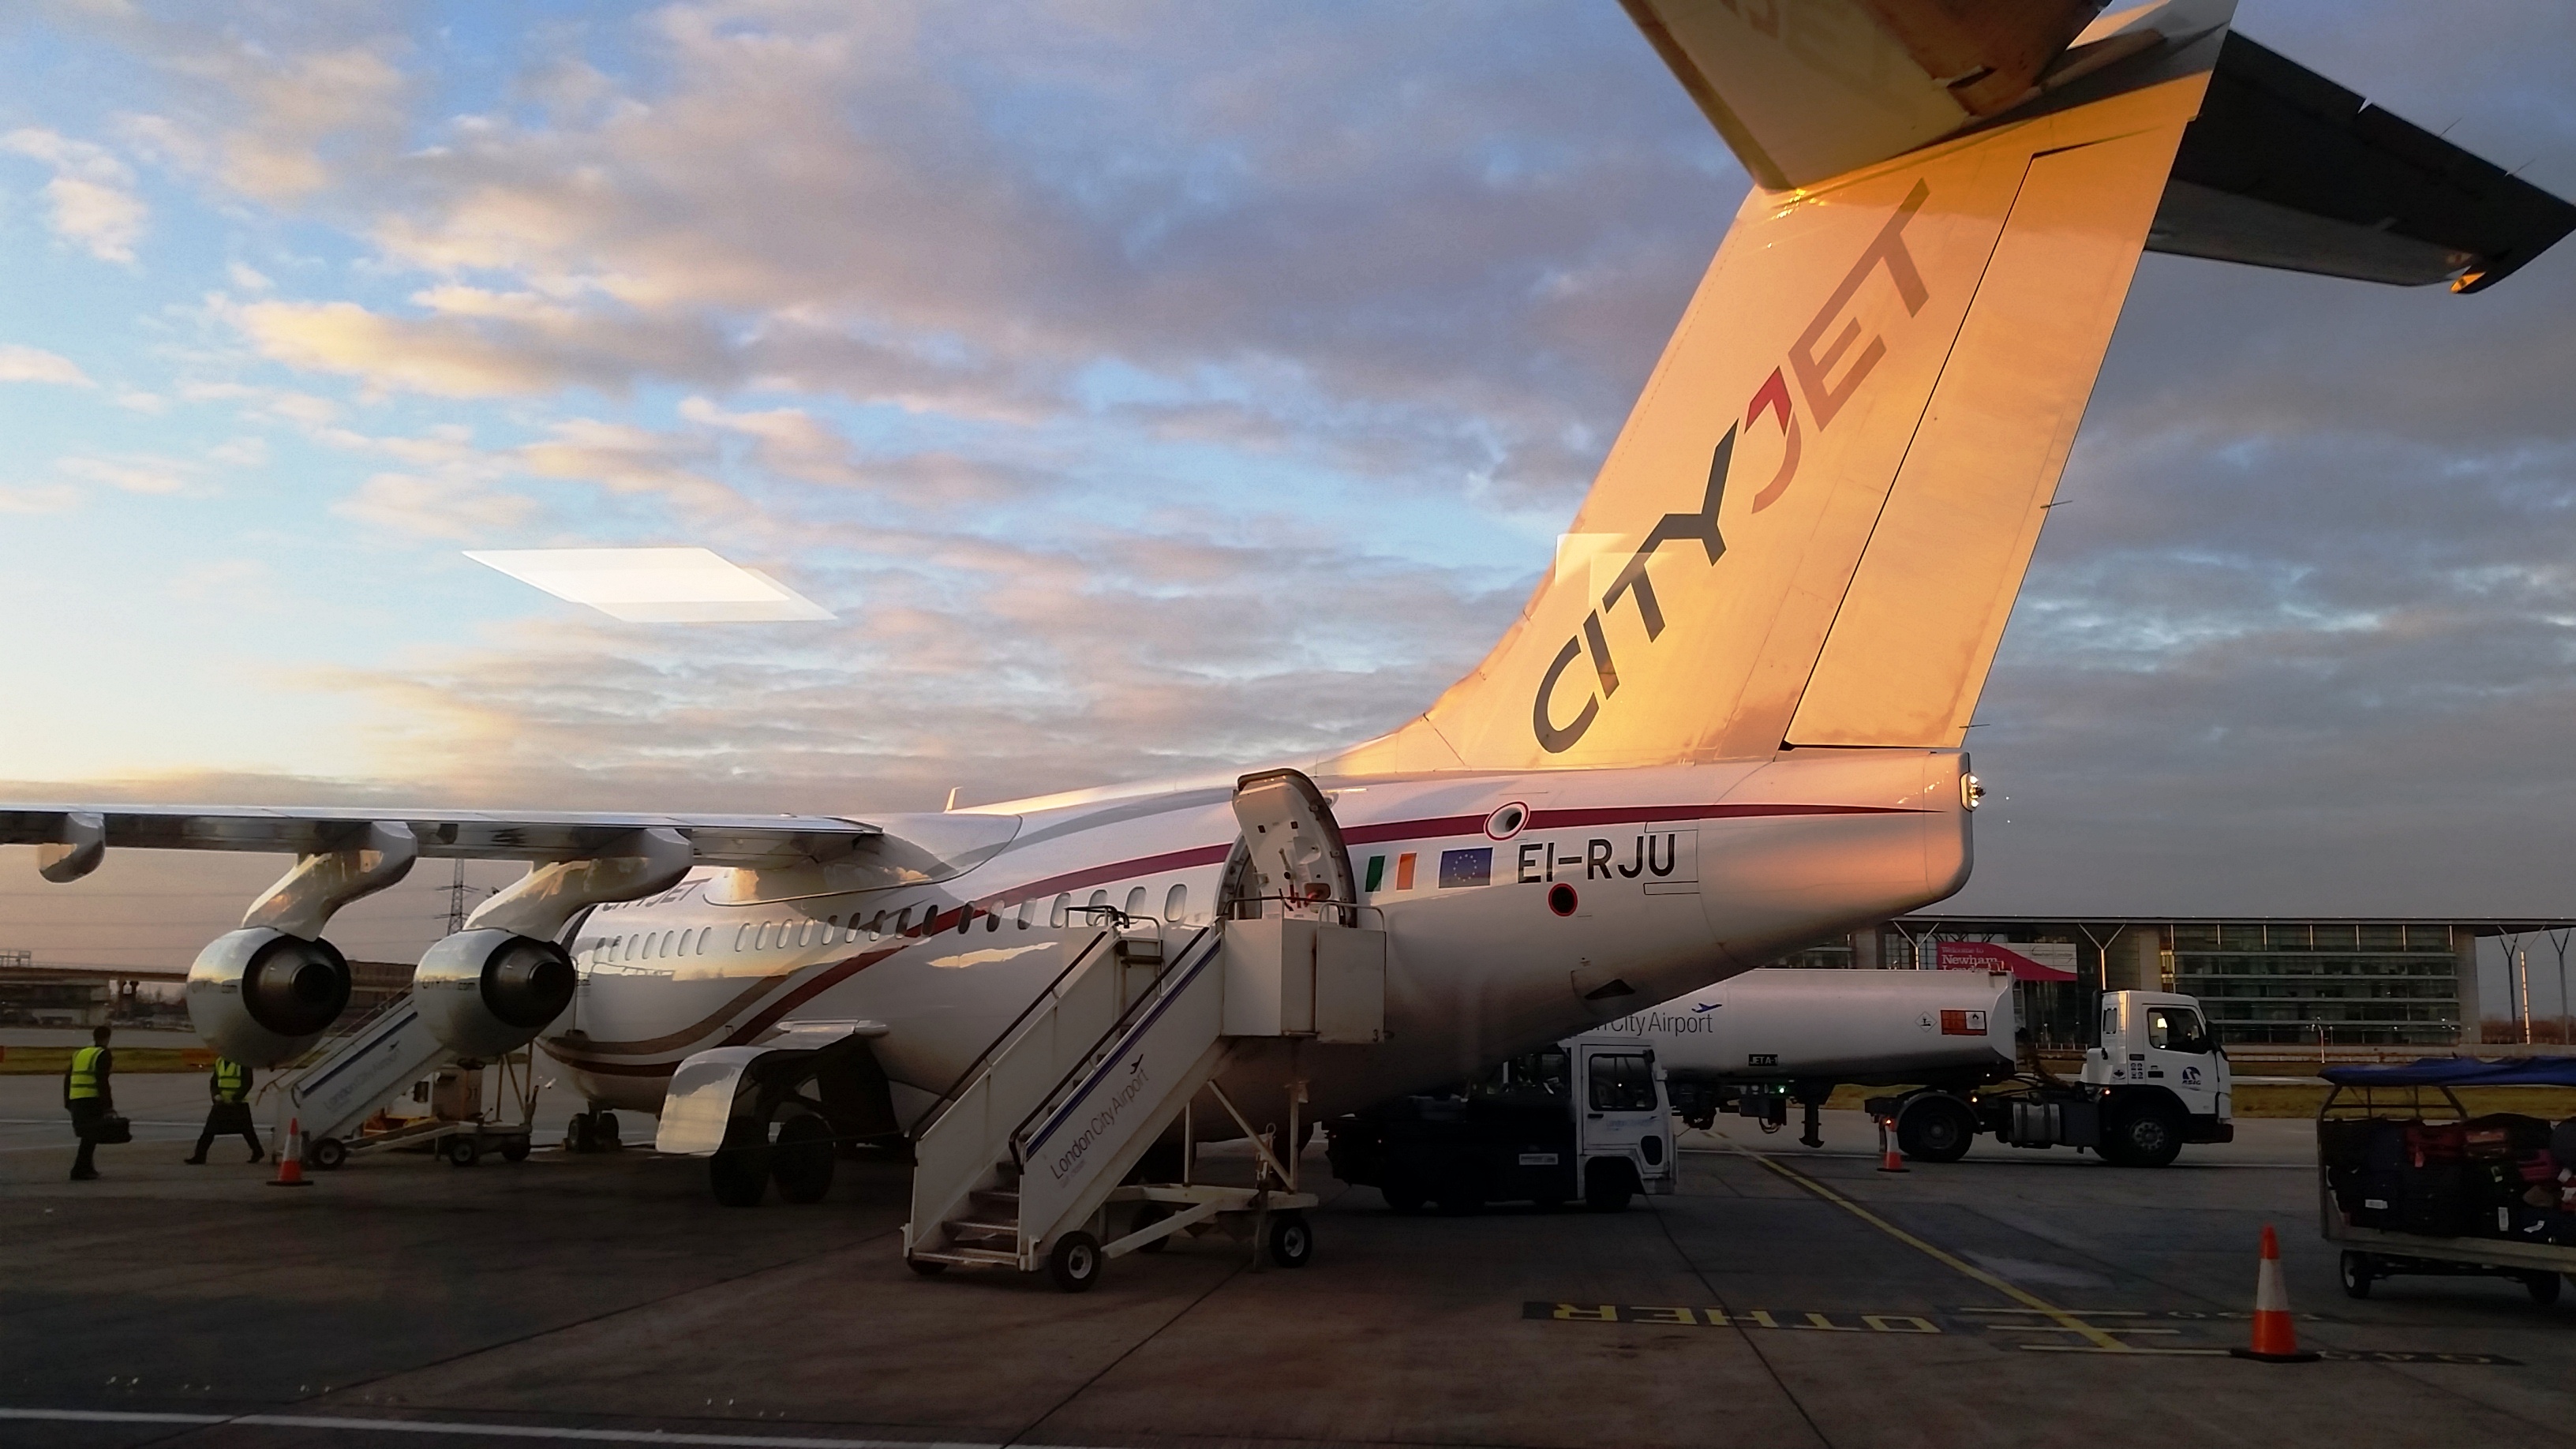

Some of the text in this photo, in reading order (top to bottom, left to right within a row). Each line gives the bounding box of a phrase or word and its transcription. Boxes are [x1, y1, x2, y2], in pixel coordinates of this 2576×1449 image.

[1533, 177, 1930, 753] CITYJET
[1517, 833, 1676, 884] EI-RJU
[1941, 954, 1998, 964] Newham
[1648, 1012, 1713, 1037] Airport
[1750, 1056, 1778, 1065] JET A-1
[1050, 1129, 1095, 1179] London
[1091, 1105, 1115, 1136] City
[1111, 1068, 1149, 1115] Airport
[1553, 1303, 1943, 1334] OTHER
